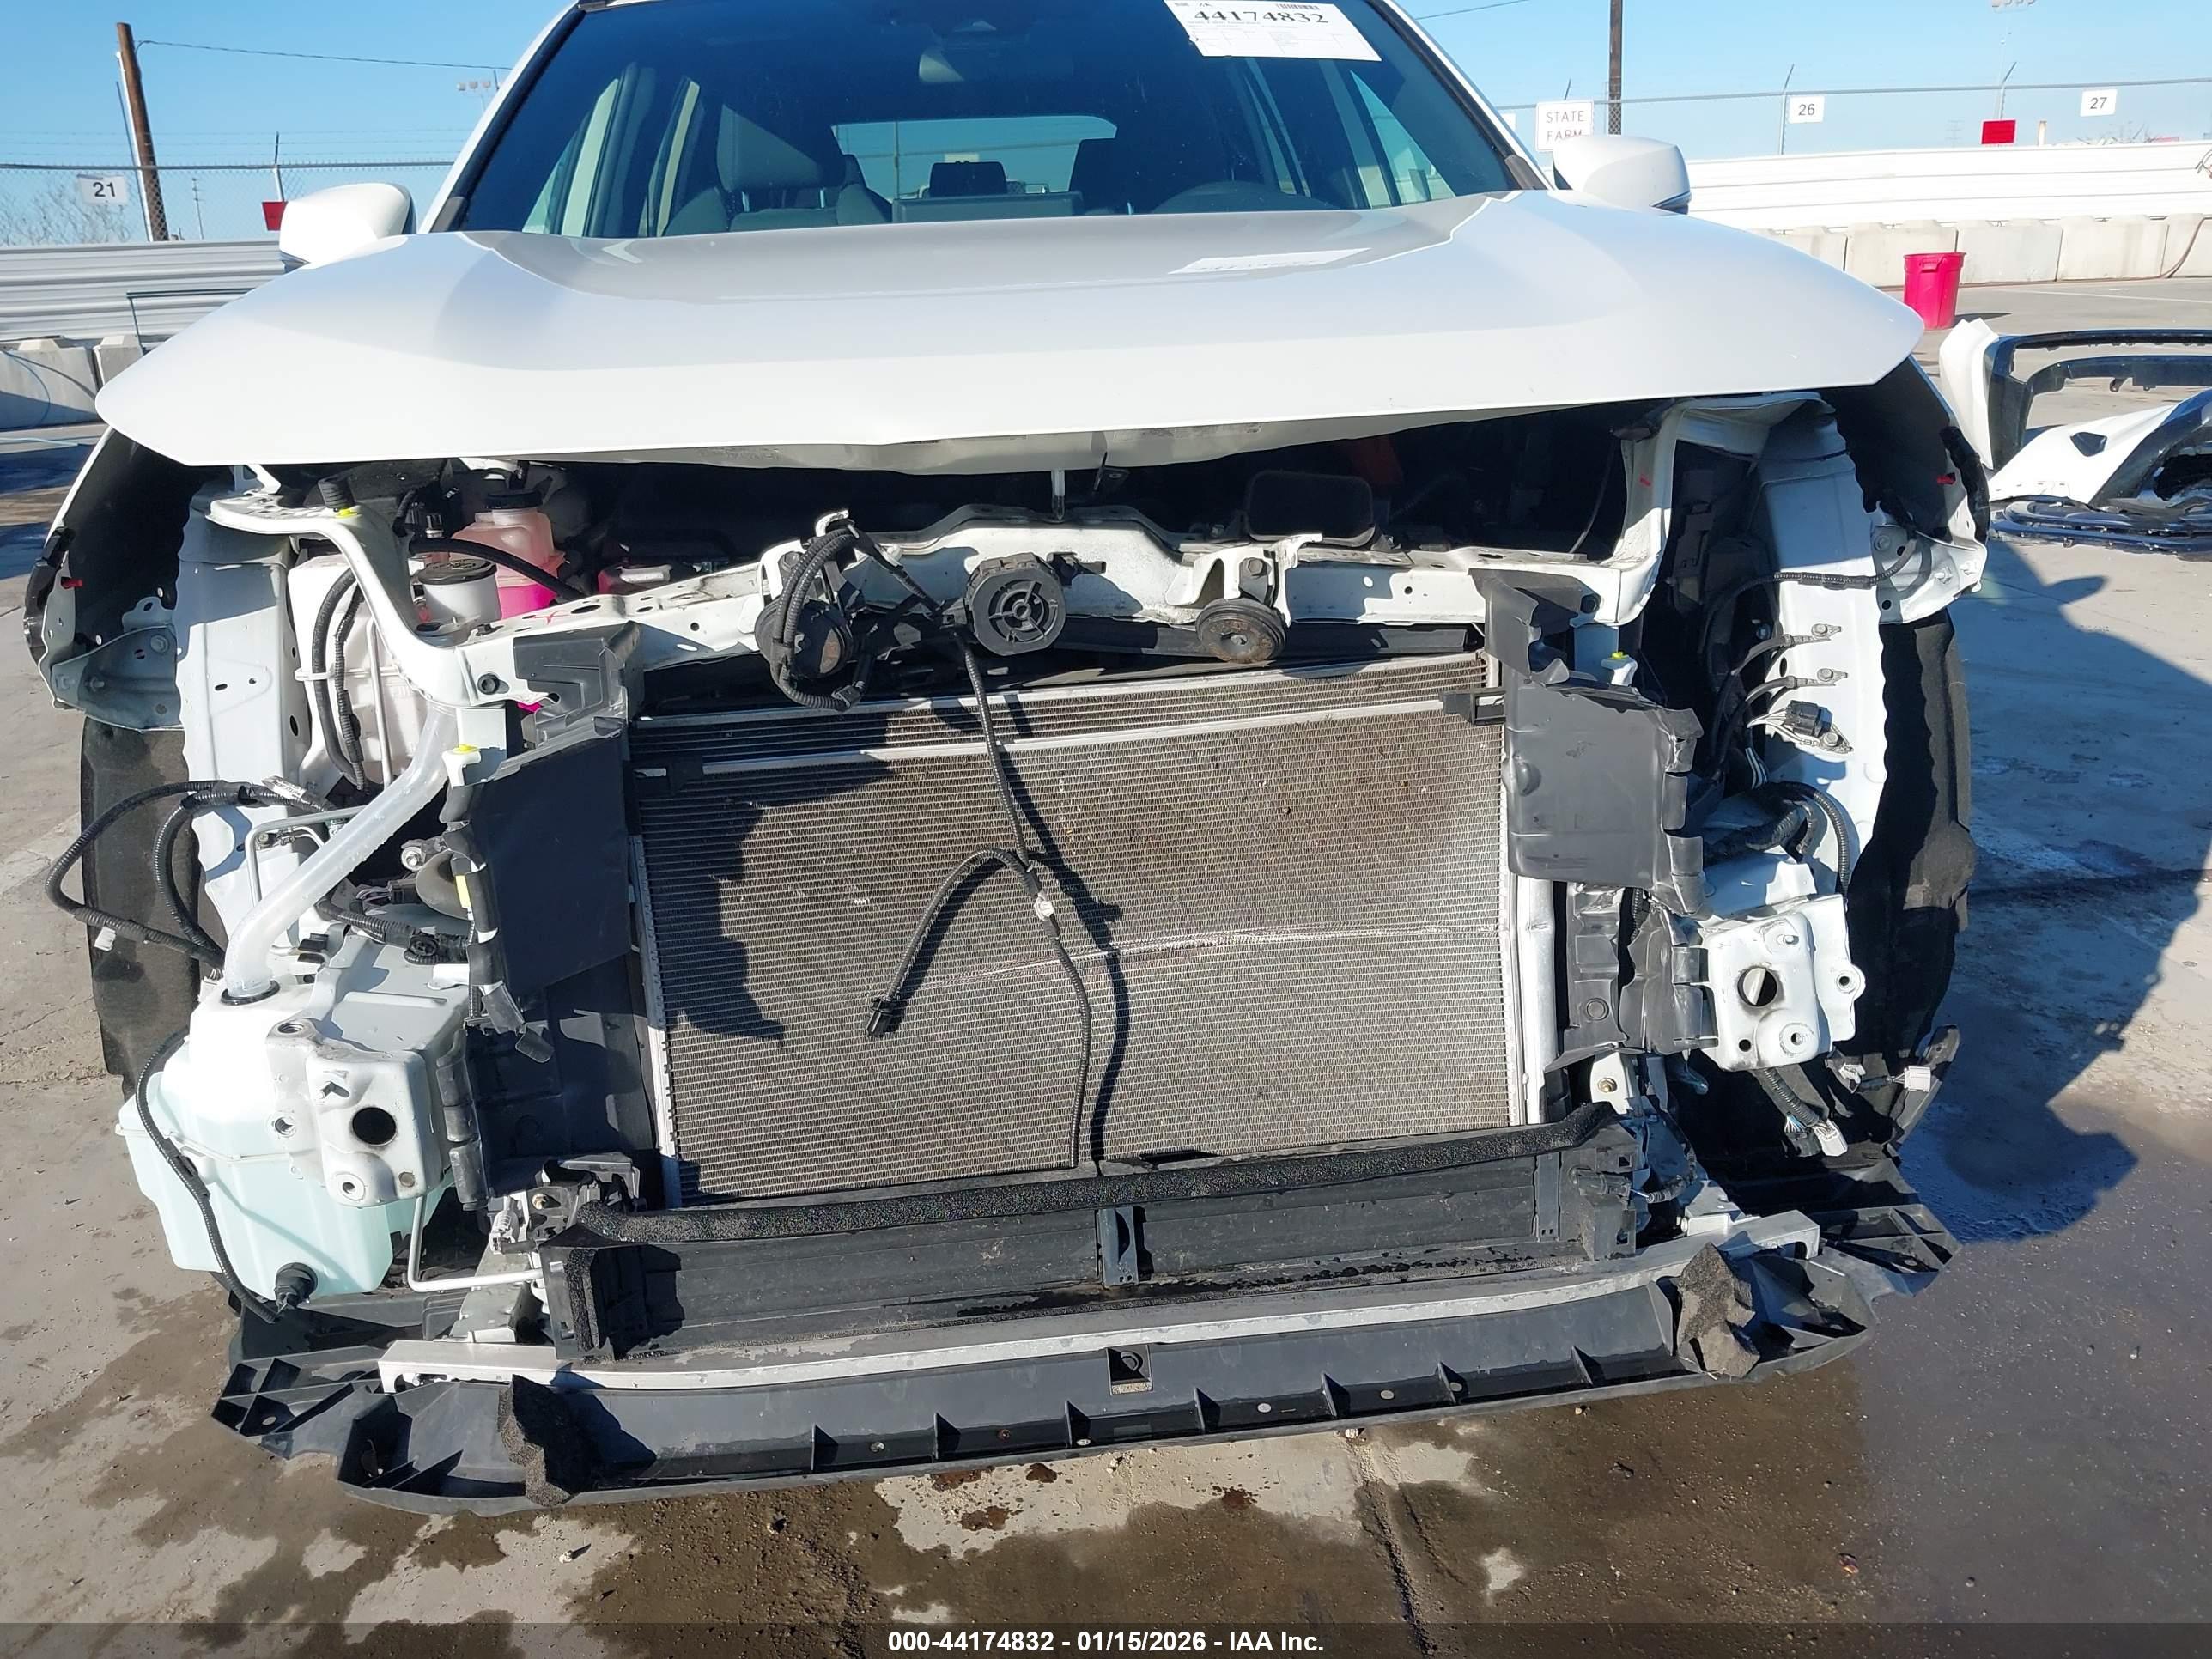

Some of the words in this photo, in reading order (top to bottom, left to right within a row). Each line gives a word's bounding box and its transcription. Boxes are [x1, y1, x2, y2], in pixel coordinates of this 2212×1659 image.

[1194, 10, 1329, 24] 44174832
[1798, 104, 1815, 117] 26
[2089, 96, 2108, 111] 27
[1546, 110, 1585, 124] STATE
[92, 182, 116, 198] 21
